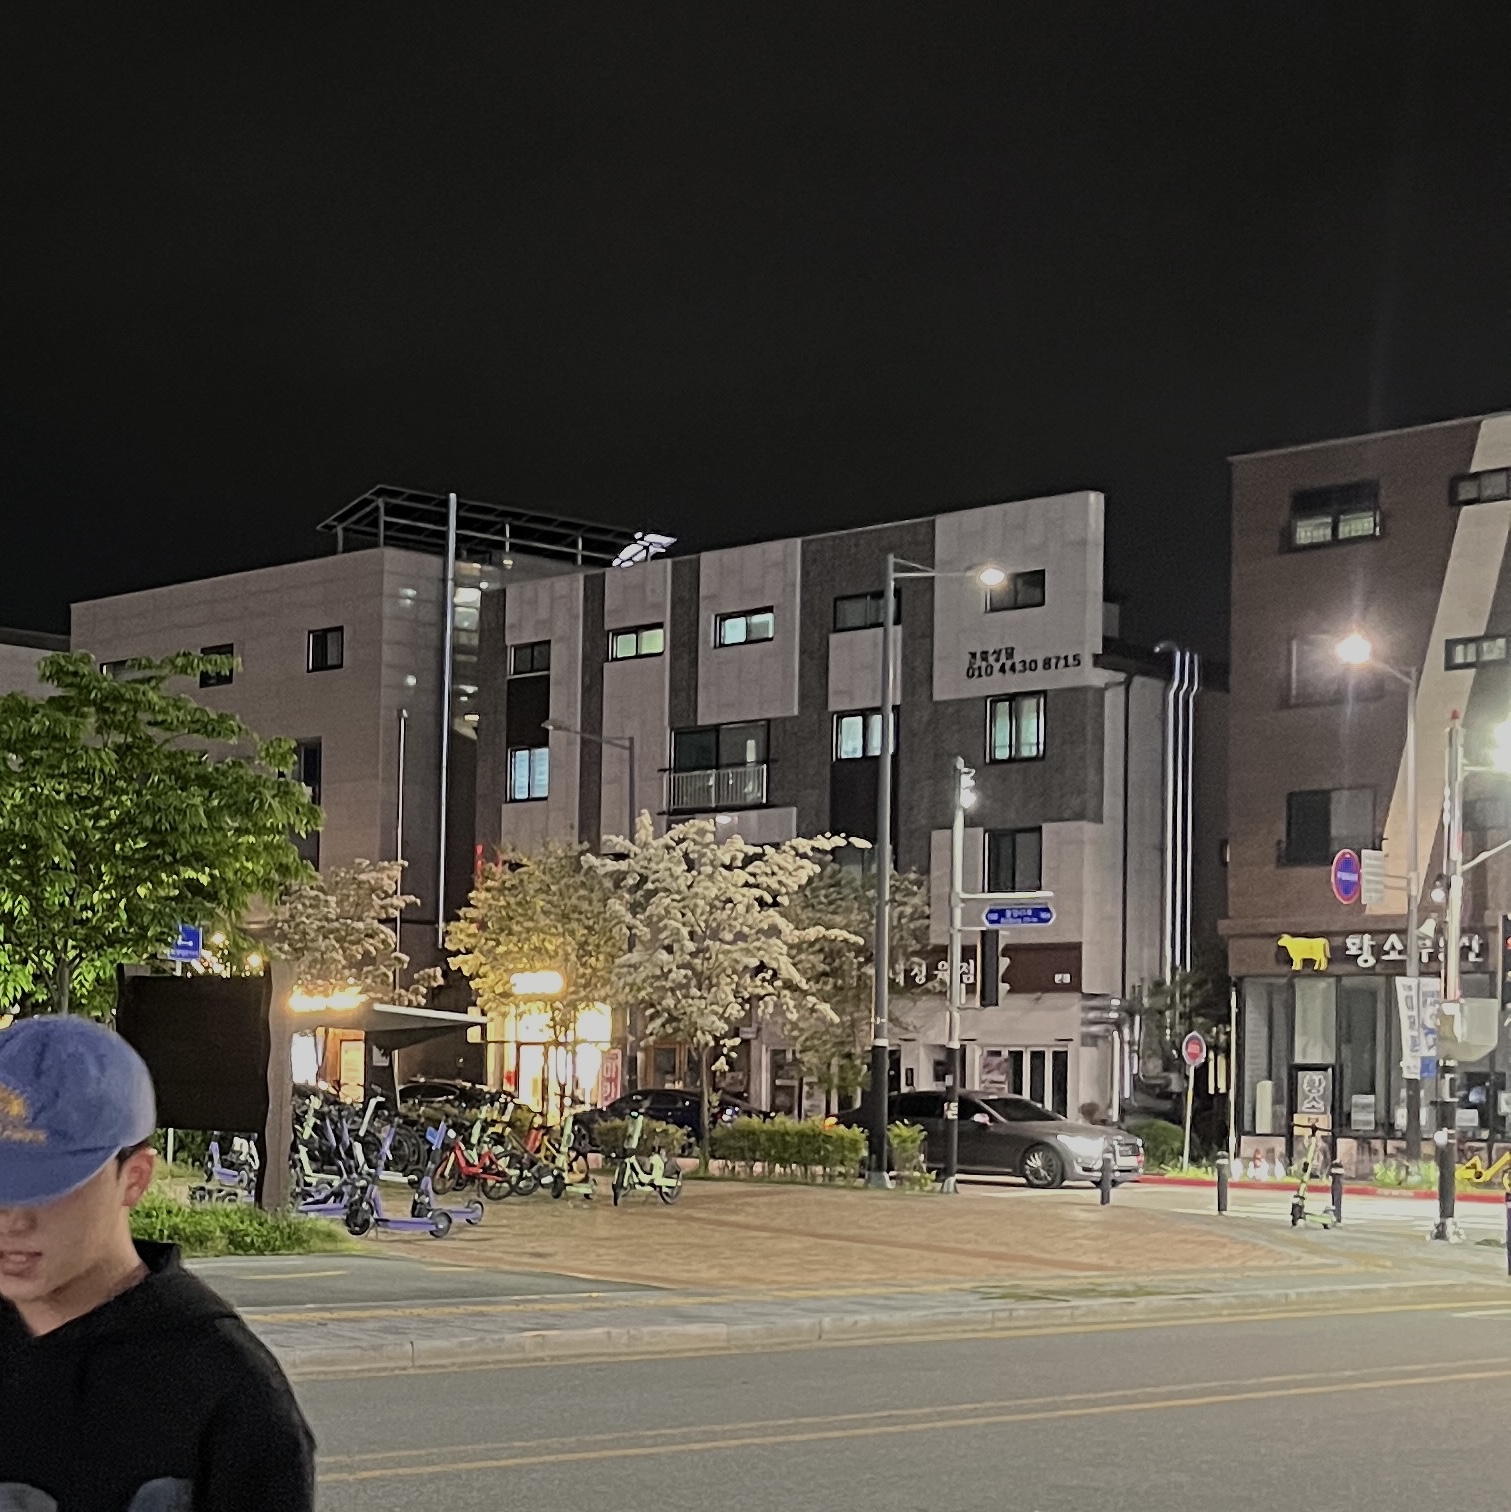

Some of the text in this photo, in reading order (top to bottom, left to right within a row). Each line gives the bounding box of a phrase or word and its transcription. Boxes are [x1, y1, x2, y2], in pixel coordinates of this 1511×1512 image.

[966, 652, 1081, 679] 010 4430 8715
